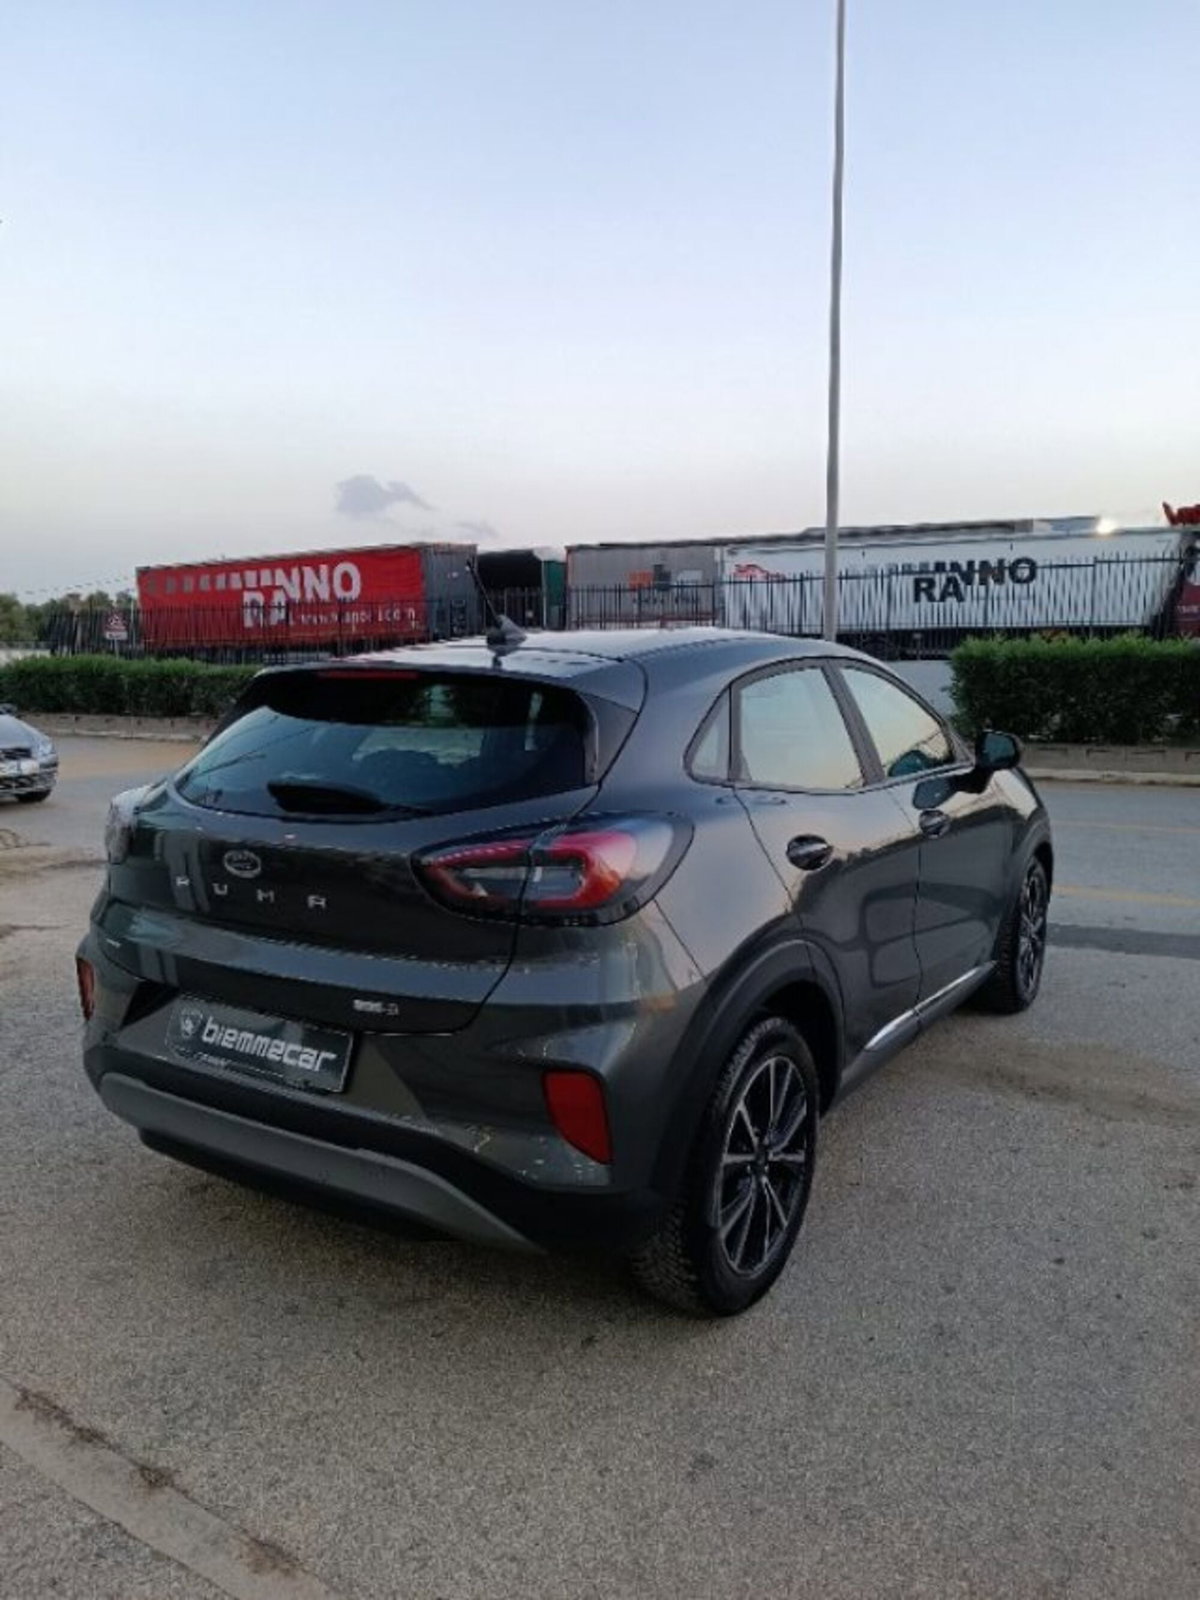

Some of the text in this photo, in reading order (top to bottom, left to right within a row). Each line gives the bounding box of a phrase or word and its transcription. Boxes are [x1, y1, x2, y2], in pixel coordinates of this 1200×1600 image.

[913, 576, 966, 603] RA
[175, 875, 326, 909] PUMA
[201, 1015, 338, 1073] biemmecar
